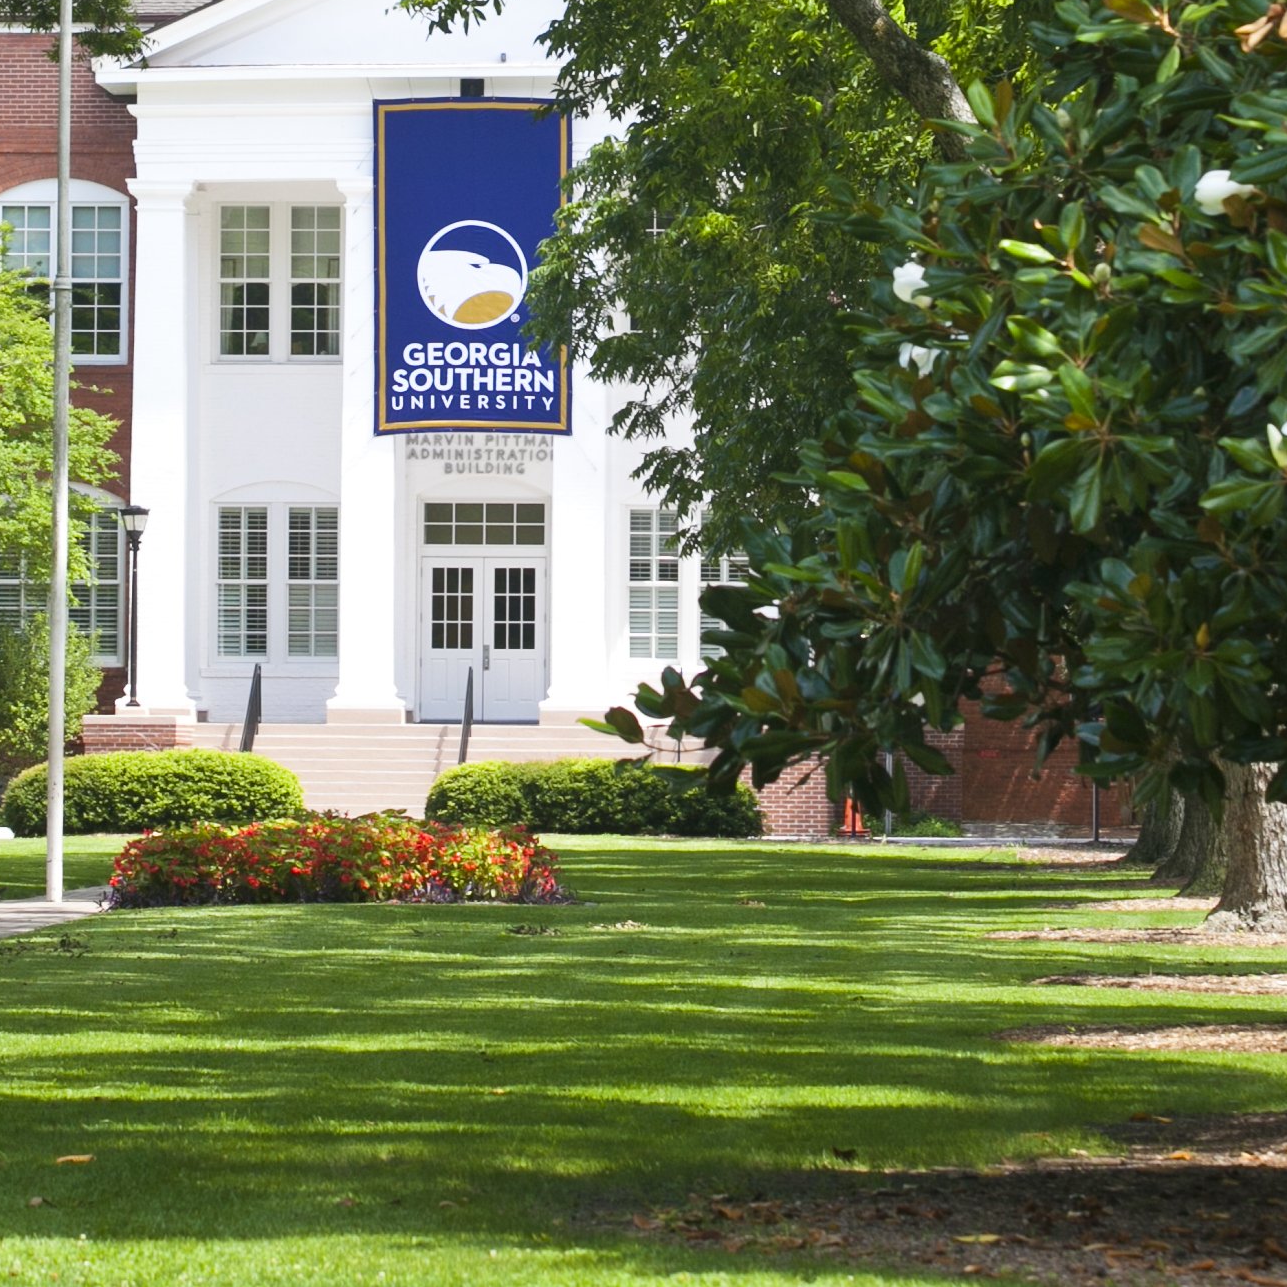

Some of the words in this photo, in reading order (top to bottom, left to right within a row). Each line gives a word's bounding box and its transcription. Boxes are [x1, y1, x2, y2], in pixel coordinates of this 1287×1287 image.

[403, 342, 542, 367] GEORGIA
[392, 368, 554, 393] SOUTHERN
[391, 395, 554, 411] UNIVERSITY
[406, 434, 474, 447] MARVIN
[444, 462, 526, 475] BUILDING
